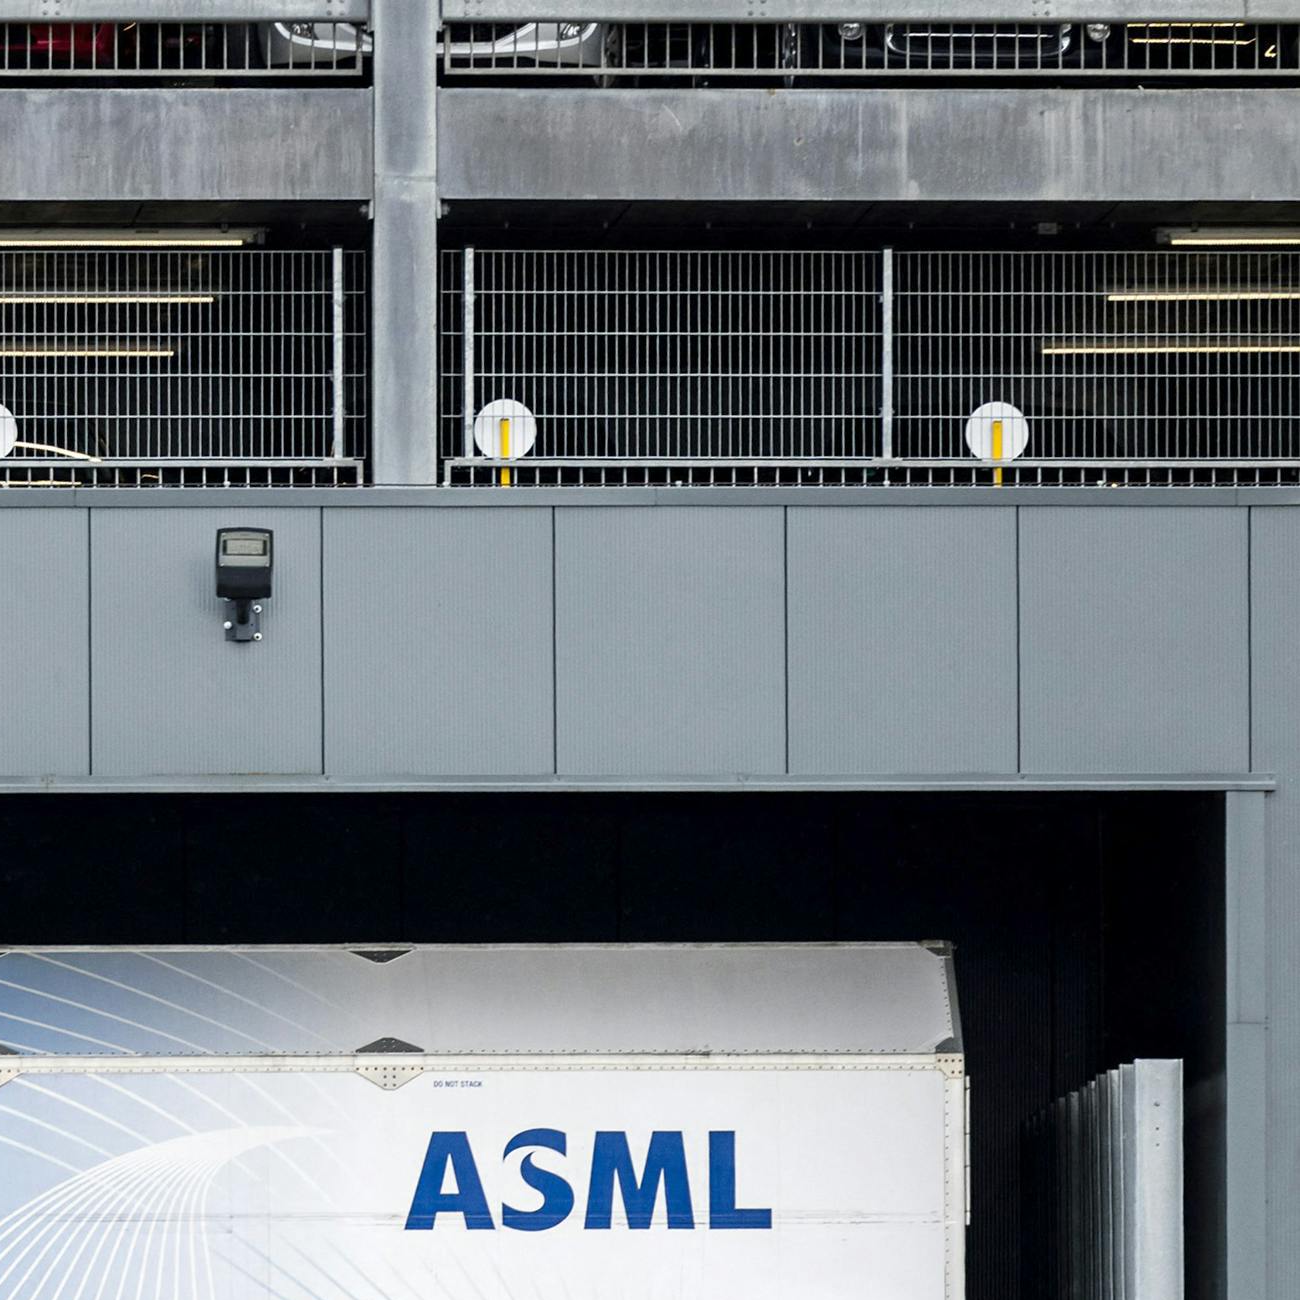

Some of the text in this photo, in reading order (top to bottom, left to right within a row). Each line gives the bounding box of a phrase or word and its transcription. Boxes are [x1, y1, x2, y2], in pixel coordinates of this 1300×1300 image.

[433, 1080, 483, 1088] DO NOT STACK
[404, 1127, 772, 1231] ASML
